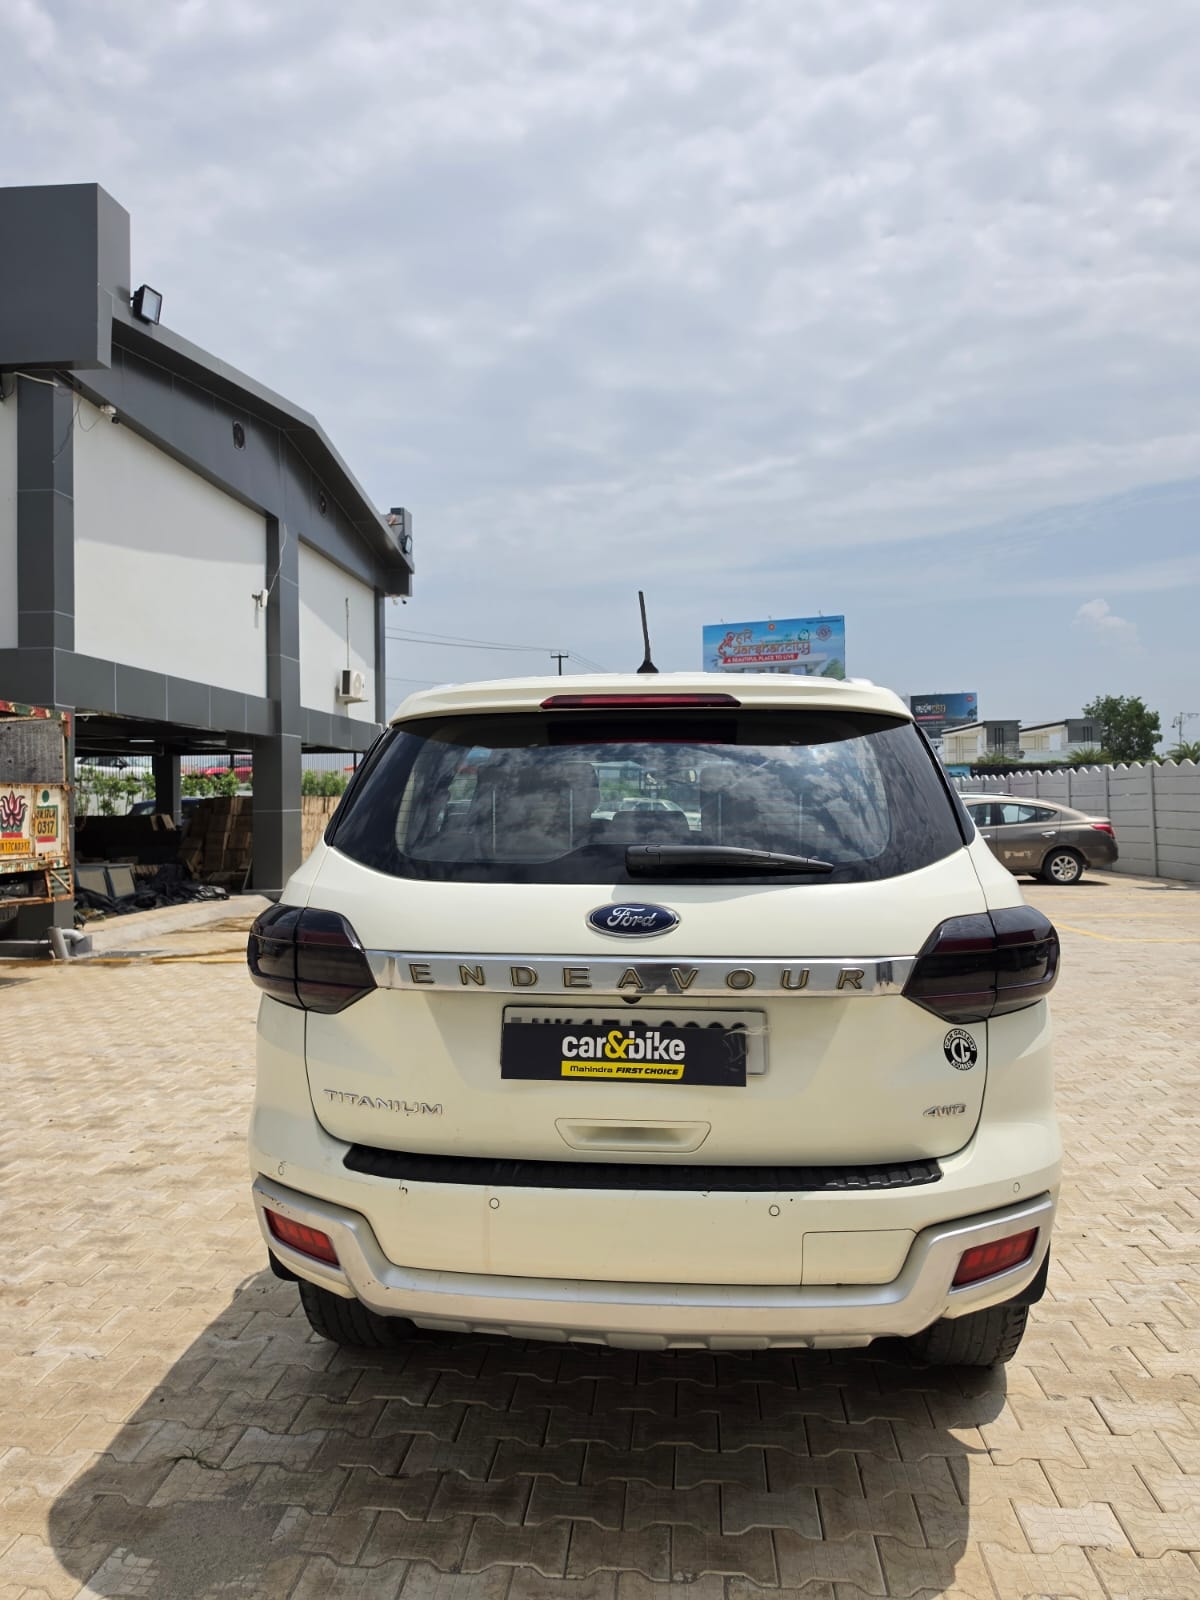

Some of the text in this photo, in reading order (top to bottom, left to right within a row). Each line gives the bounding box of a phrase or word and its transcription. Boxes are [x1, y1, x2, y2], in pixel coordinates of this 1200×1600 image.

[37, 821, 55, 834] 0317
[606, 907, 658, 927] Ford
[408, 963, 866, 990] ENDEAVOUR
[562, 1030, 686, 1060] car&bike
[569, 1065, 680, 1076] Mahindra FIRST CHOICE
[323, 1088, 444, 1116] TITANIUM
[922, 1103, 966, 1118] 4WD
